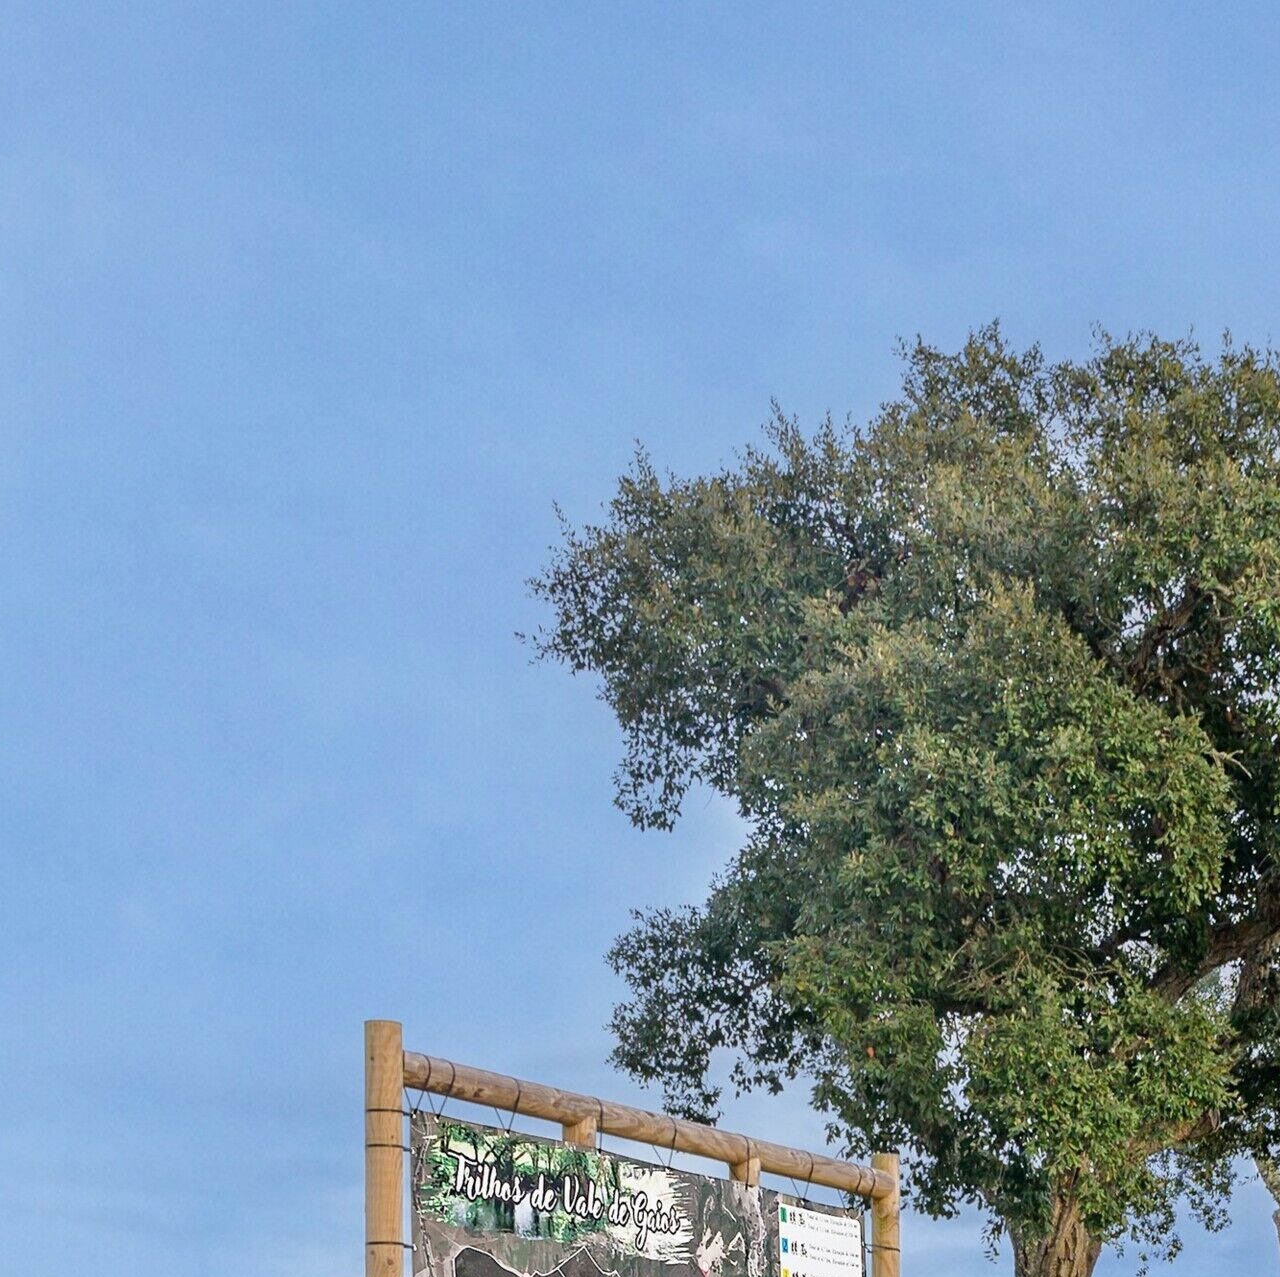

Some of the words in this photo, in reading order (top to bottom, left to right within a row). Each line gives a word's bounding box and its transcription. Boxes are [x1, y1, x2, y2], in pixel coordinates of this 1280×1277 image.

[447, 1151, 525, 1203] Trilhos
[531, 1173, 557, 1211] de
[564, 1175, 604, 1219] Vale
[609, 1191, 631, 1227] de
[631, 1191, 681, 1249] Gaios
